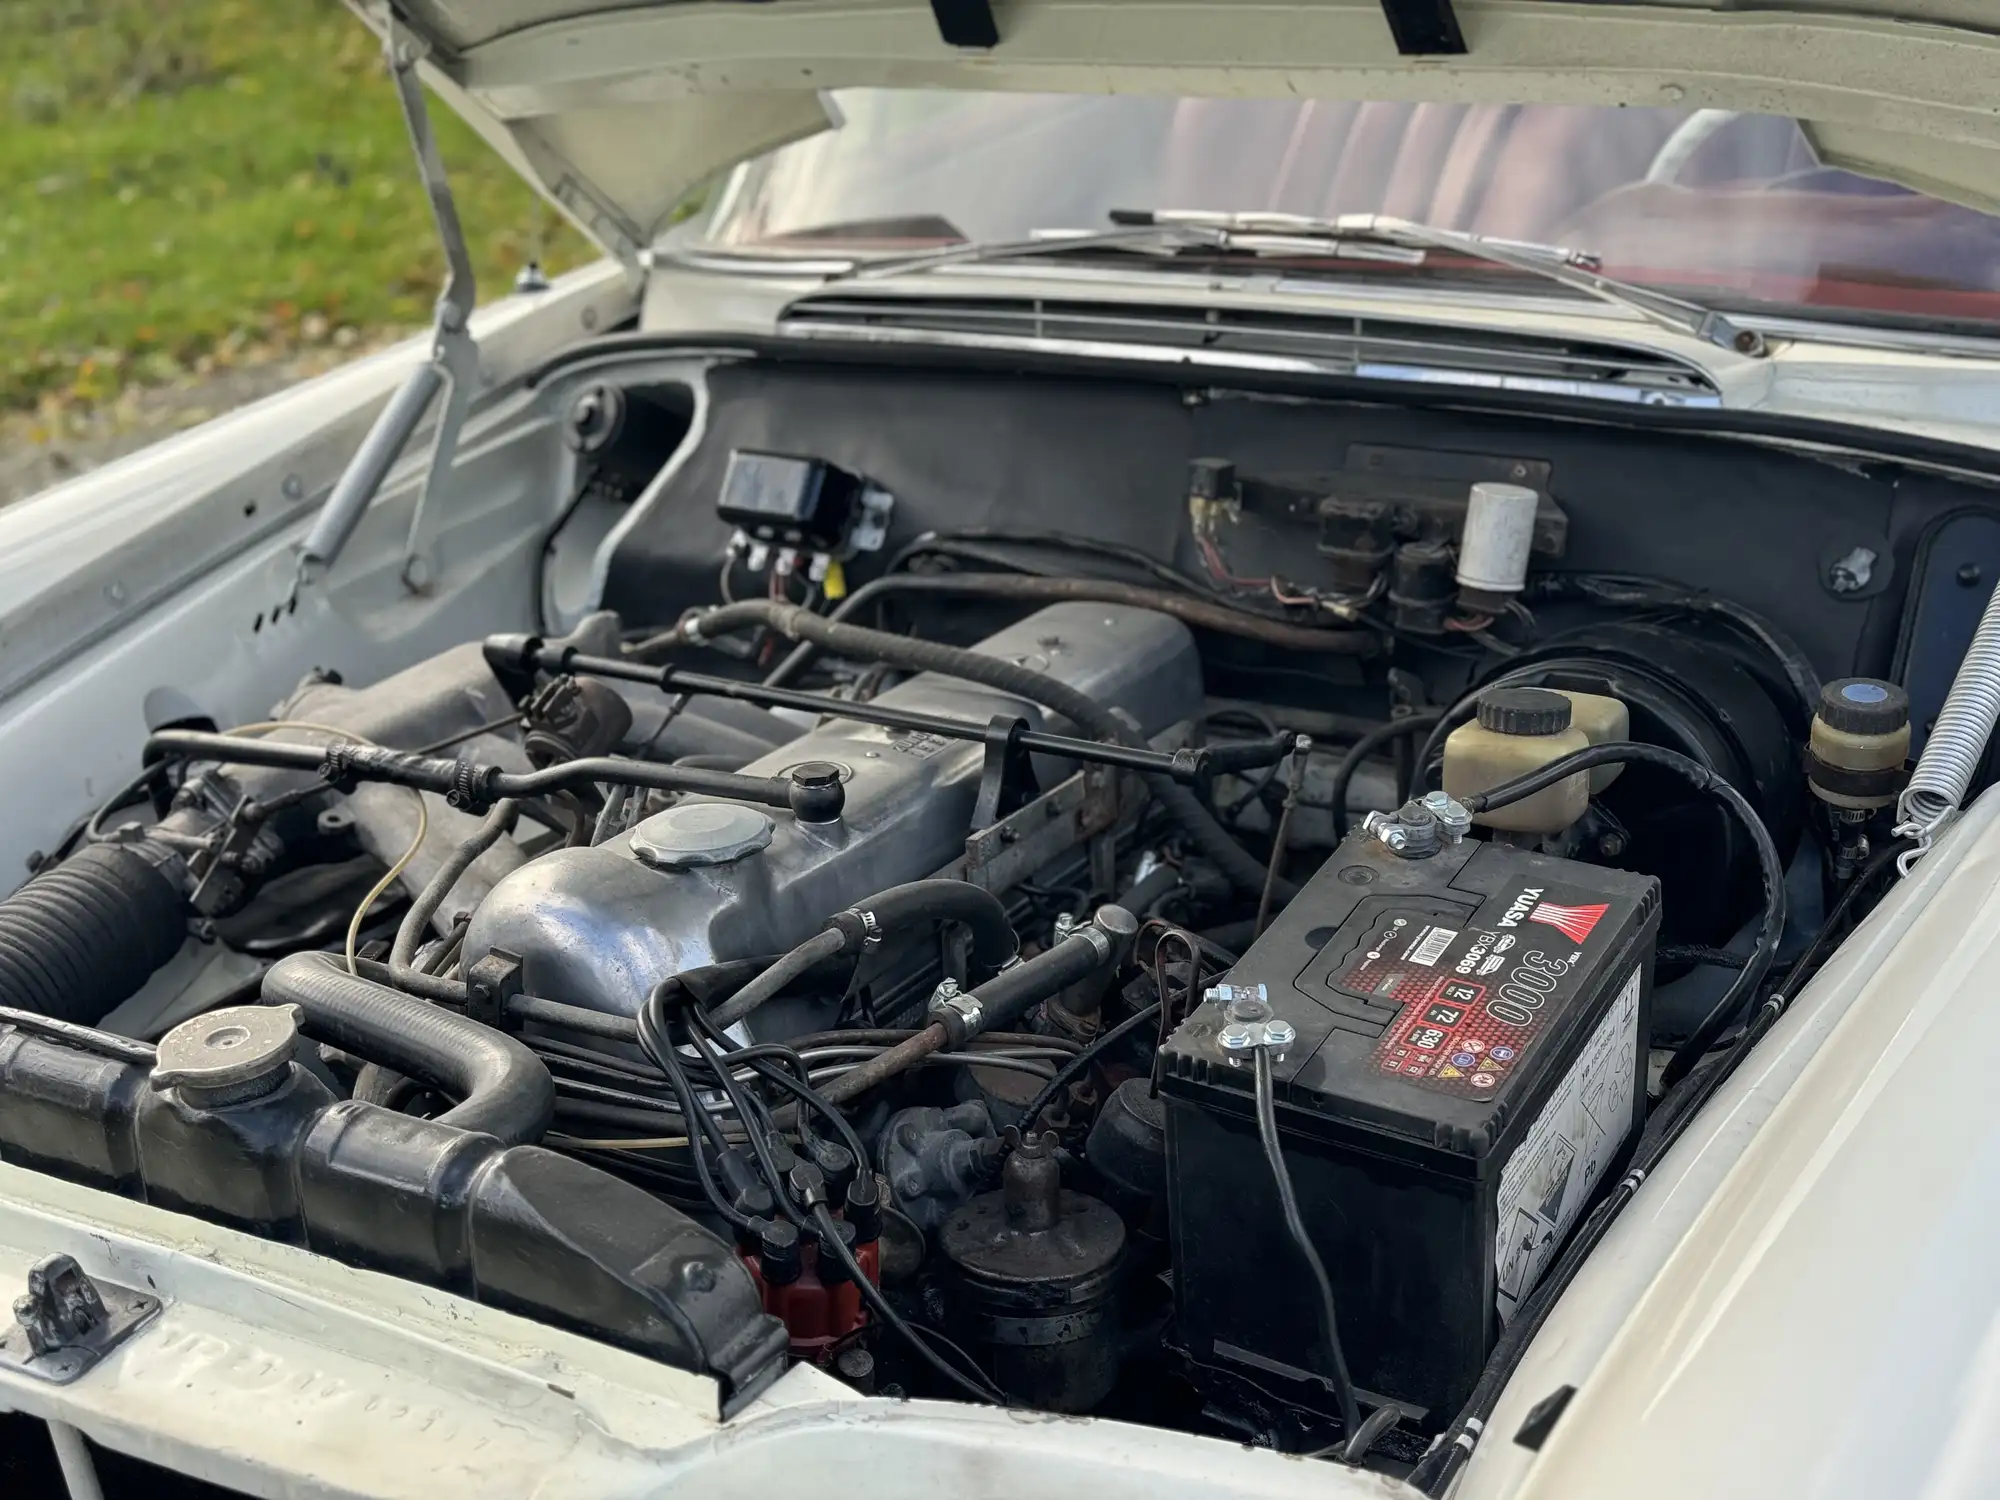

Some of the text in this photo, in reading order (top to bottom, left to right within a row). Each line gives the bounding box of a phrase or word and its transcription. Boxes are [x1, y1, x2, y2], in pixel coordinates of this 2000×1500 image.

[1497, 888, 1544, 927] YUASA
[1455, 929, 1501, 974] YBX3069
[1453, 988, 1475, 1000] 12
[1486, 950, 1569, 1027] 3000
[1435, 1009, 1459, 1024] 72
[1417, 1029, 1444, 1049] 630
